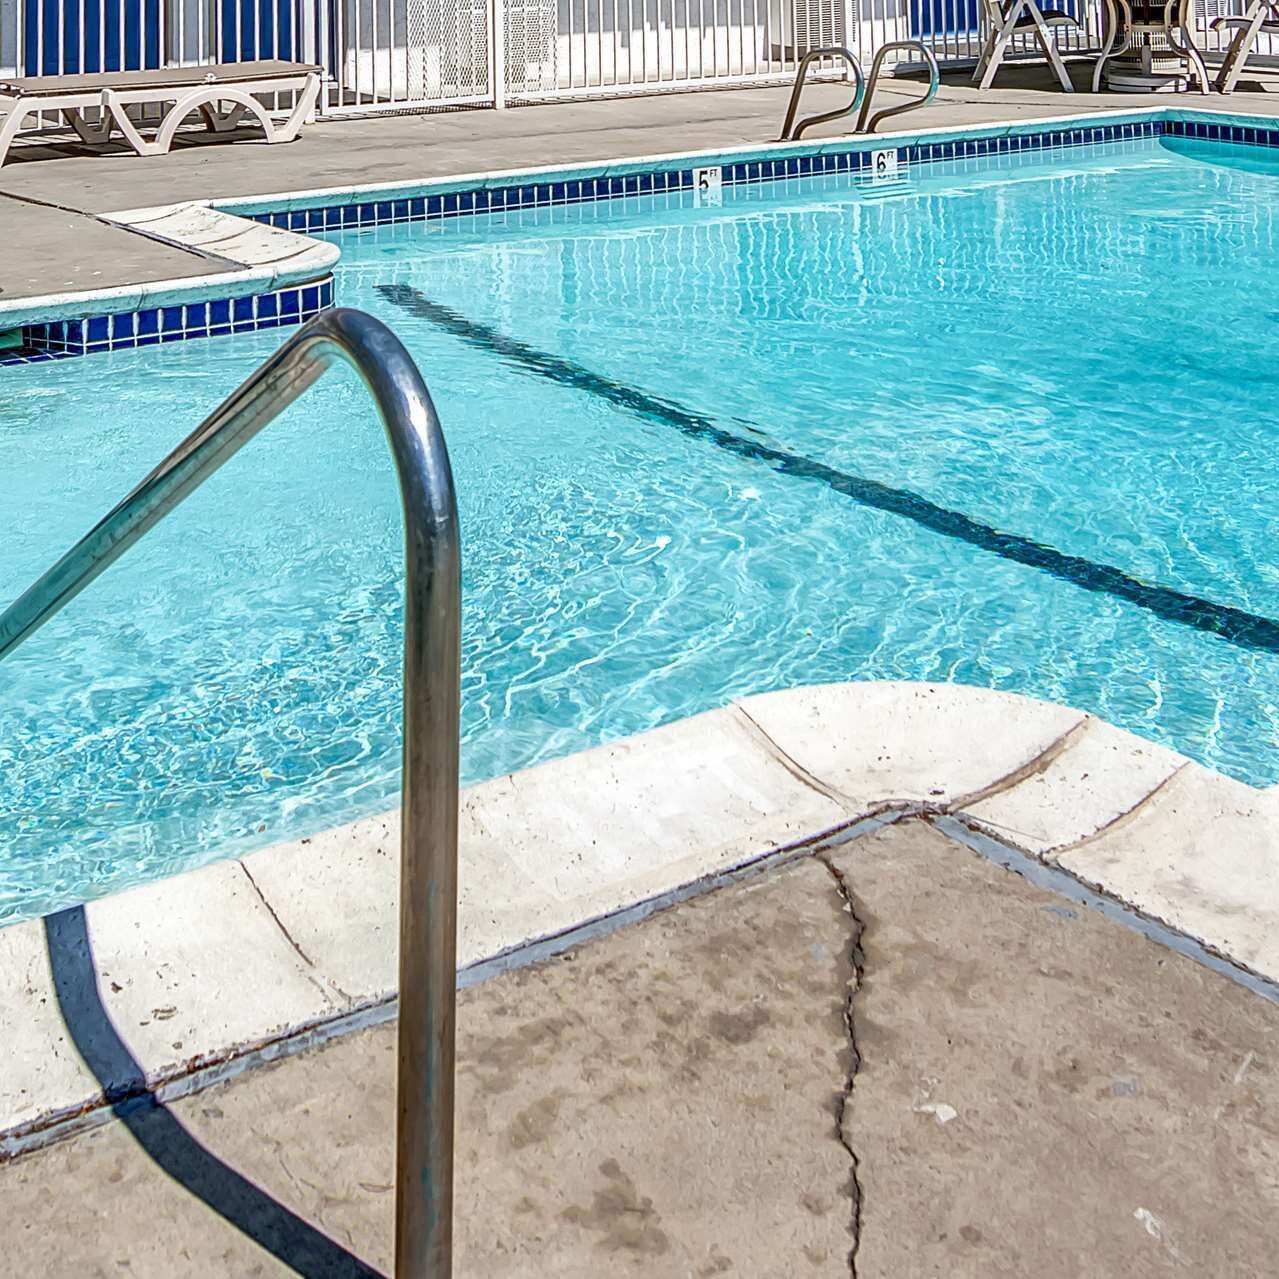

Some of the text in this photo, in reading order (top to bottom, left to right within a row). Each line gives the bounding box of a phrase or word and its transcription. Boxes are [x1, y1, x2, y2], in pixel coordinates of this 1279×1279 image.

[876, 150, 896, 173] 6 FT
[698, 168, 719, 191] 5 FT
